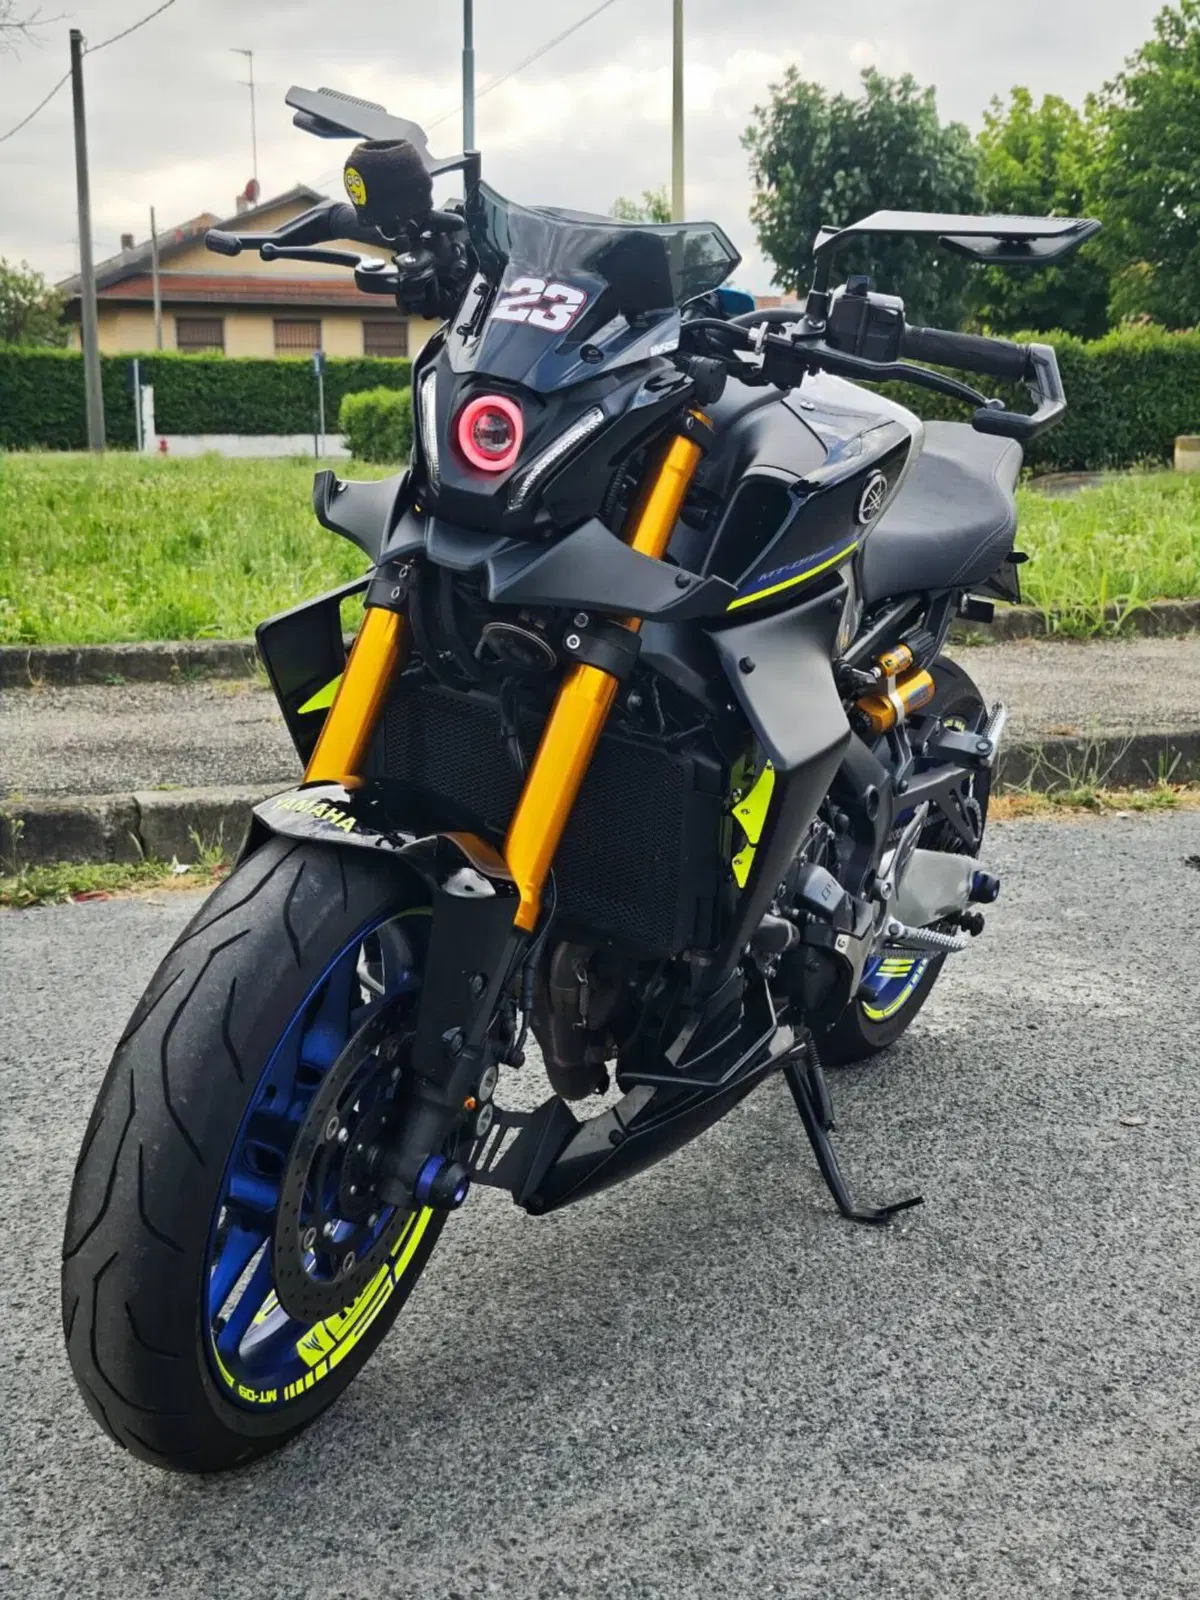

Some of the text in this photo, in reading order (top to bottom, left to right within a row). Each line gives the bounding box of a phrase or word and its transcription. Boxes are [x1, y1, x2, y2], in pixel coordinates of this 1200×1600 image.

[491, 278, 586, 331] 23
[272, 799, 357, 833] YAMAHA
[238, 1384, 277, 1403] MT-09
